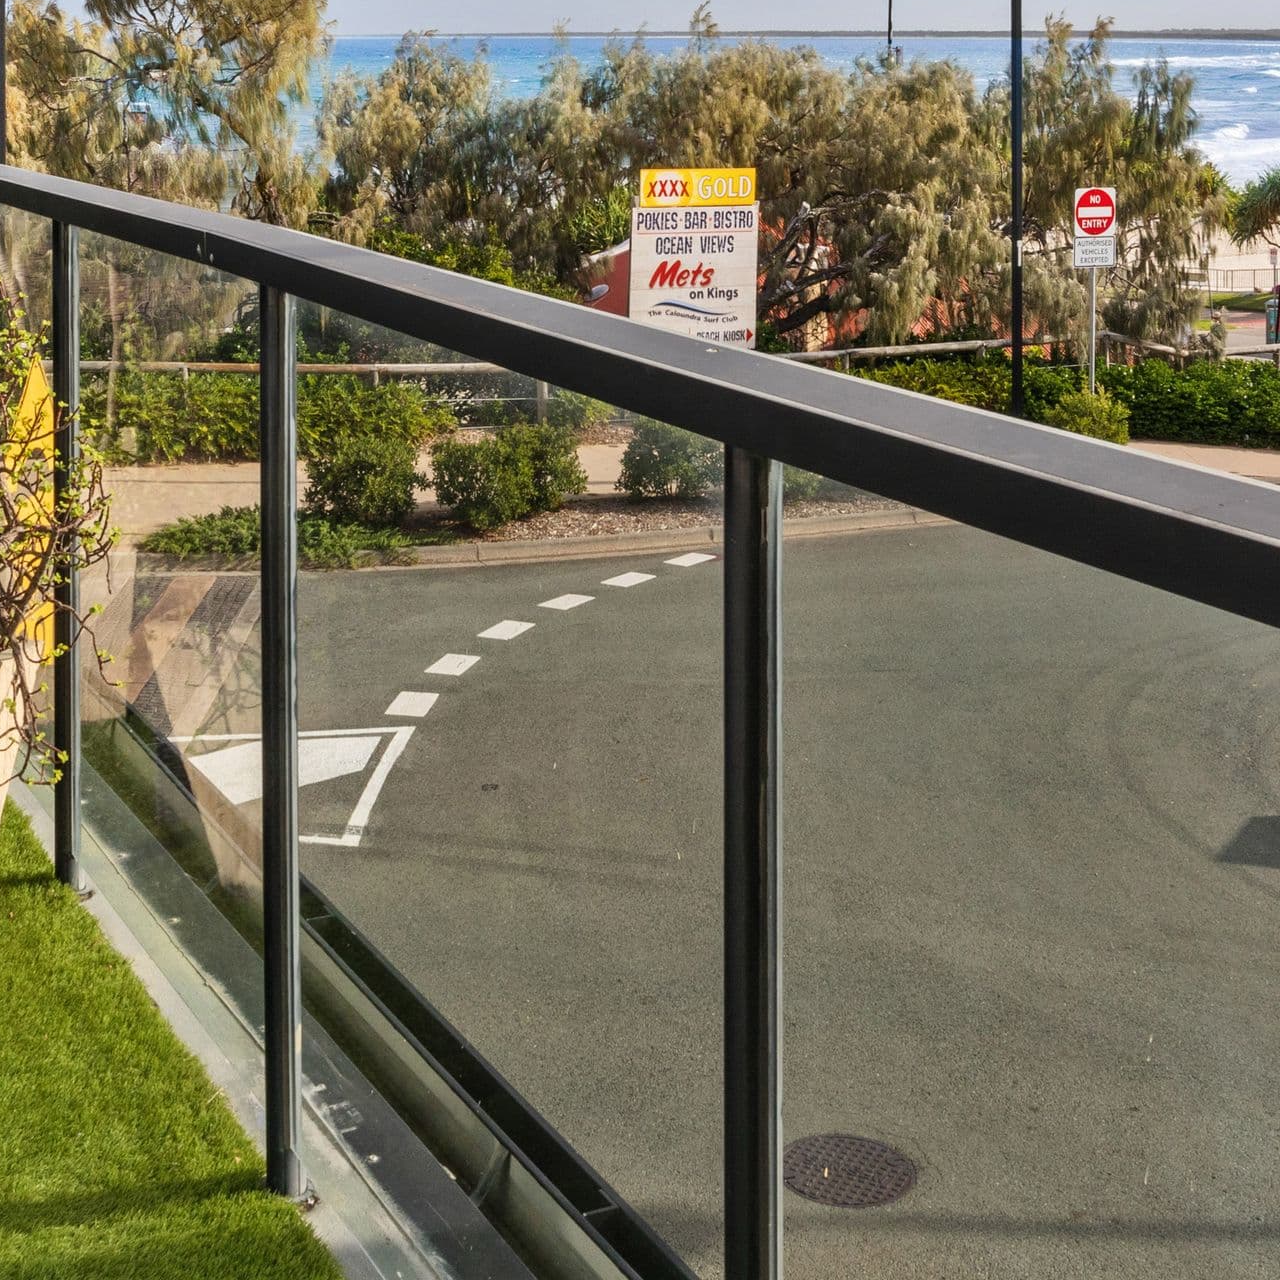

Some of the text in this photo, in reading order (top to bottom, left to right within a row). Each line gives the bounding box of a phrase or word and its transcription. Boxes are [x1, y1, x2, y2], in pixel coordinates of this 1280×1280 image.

[647, 175, 753, 200] XXXX GOLD
[1089, 194, 1101, 204] NO
[636, 210, 754, 231] POKIES BAR BISTRO
[1081, 219, 1108, 229] ENTRY
[655, 235, 735, 255] OCEAN VIEWS
[1081, 248, 1109, 256] VEHICLES
[649, 260, 715, 289] Mets
[689, 287, 739, 301] on Kings
[648, 308, 738, 324] The Caloundra Surf Club
[723, 329, 746, 342] KIOSK
